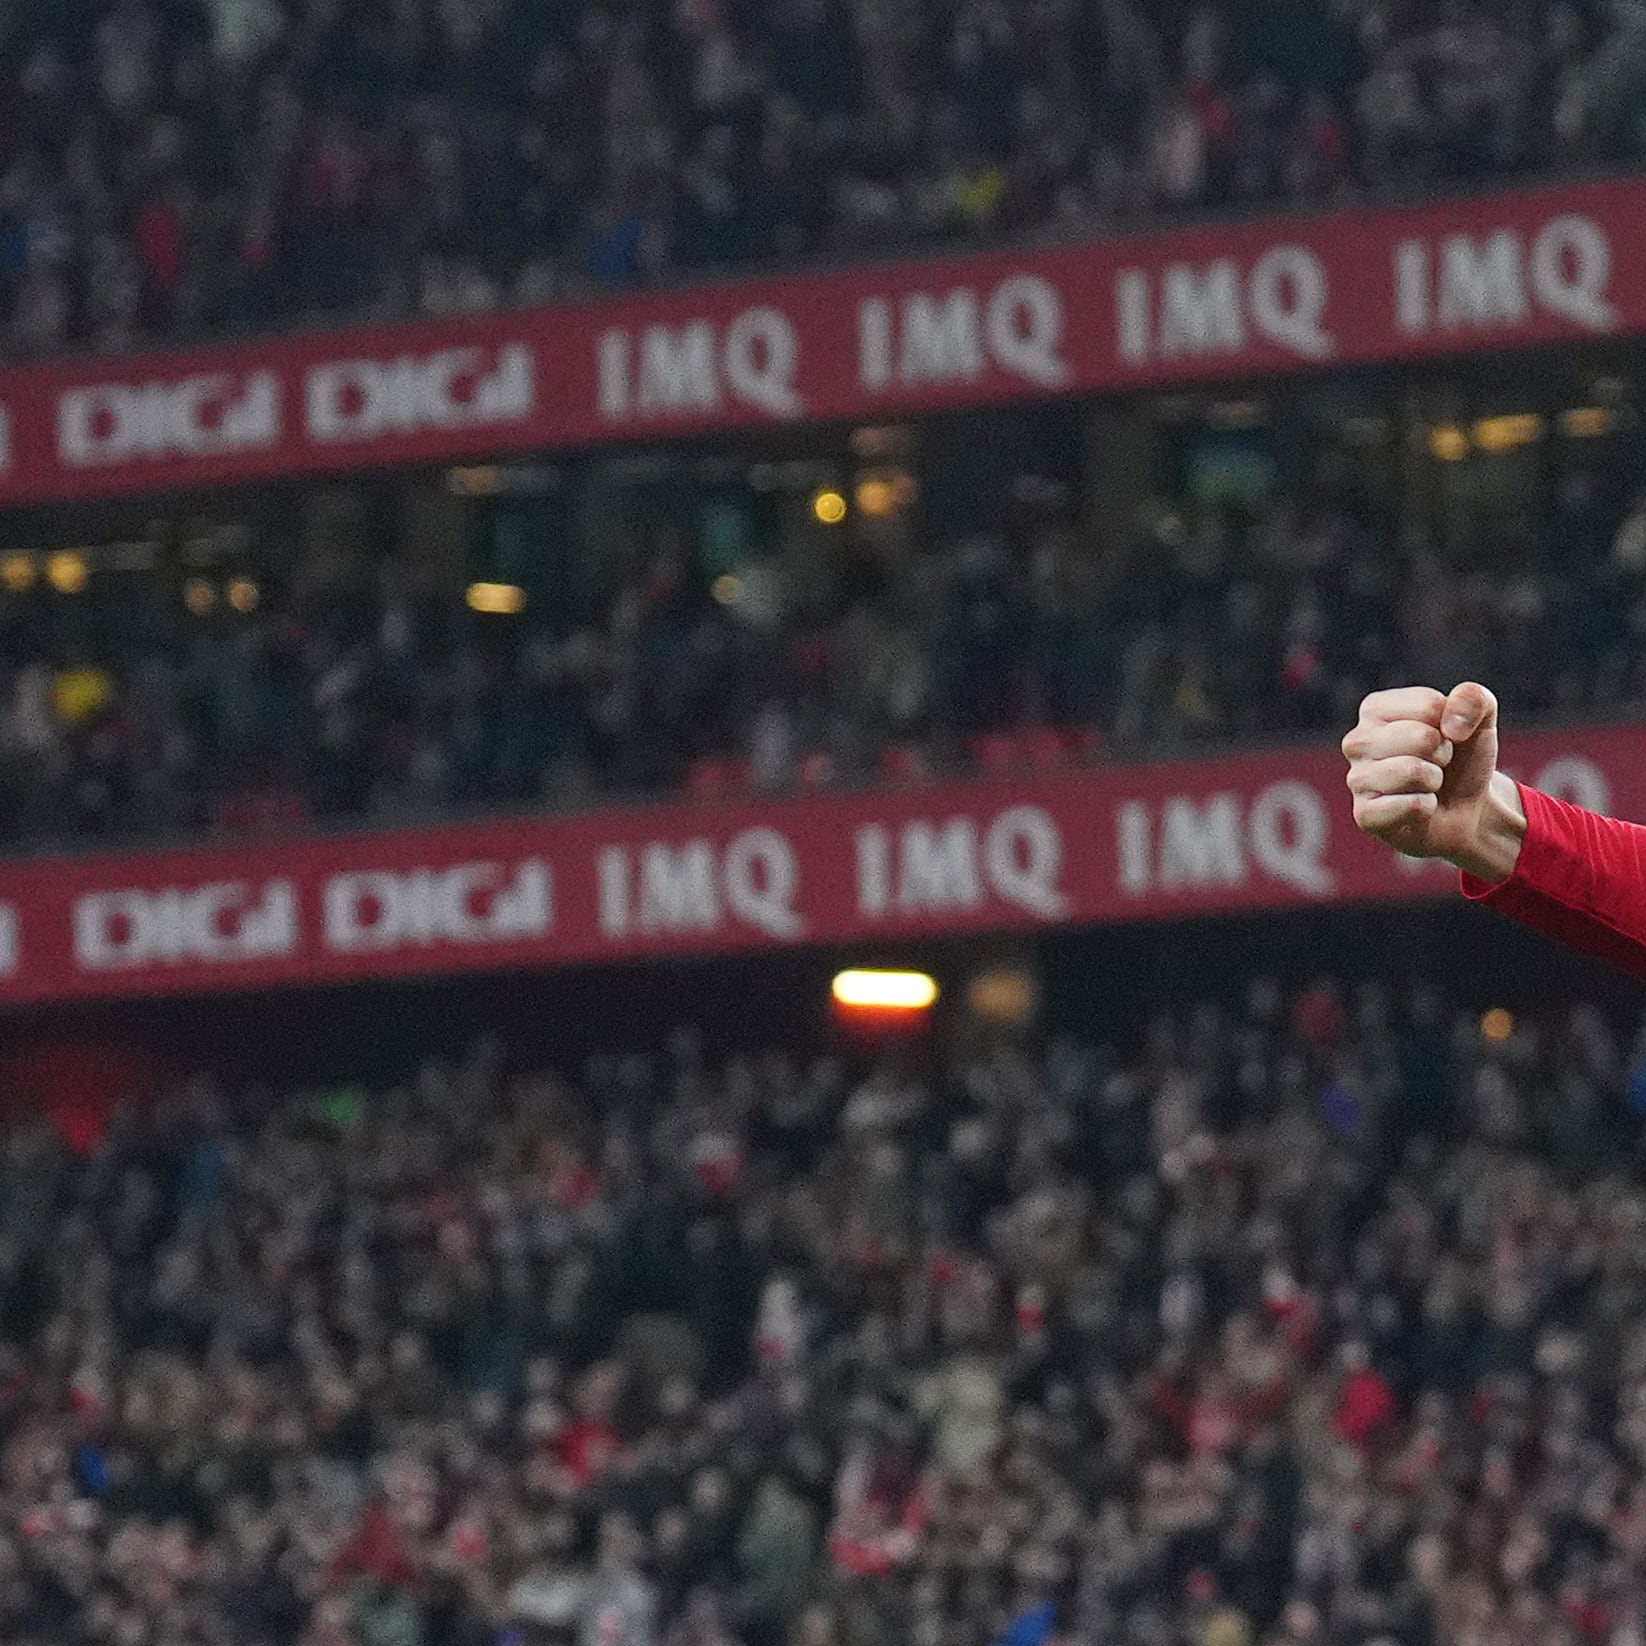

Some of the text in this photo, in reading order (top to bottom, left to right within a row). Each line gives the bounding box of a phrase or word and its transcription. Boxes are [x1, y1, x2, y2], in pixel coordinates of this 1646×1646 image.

[857, 274, 1068, 388] IMQ
[1115, 243, 1333, 361] IMQ
[1394, 212, 1618, 335] IMQ
[596, 304, 802, 421] IMQ
[597, 826, 801, 938] IMQ
[856, 805, 1068, 920] IMQ
[1118, 780, 1334, 896] IMQ
